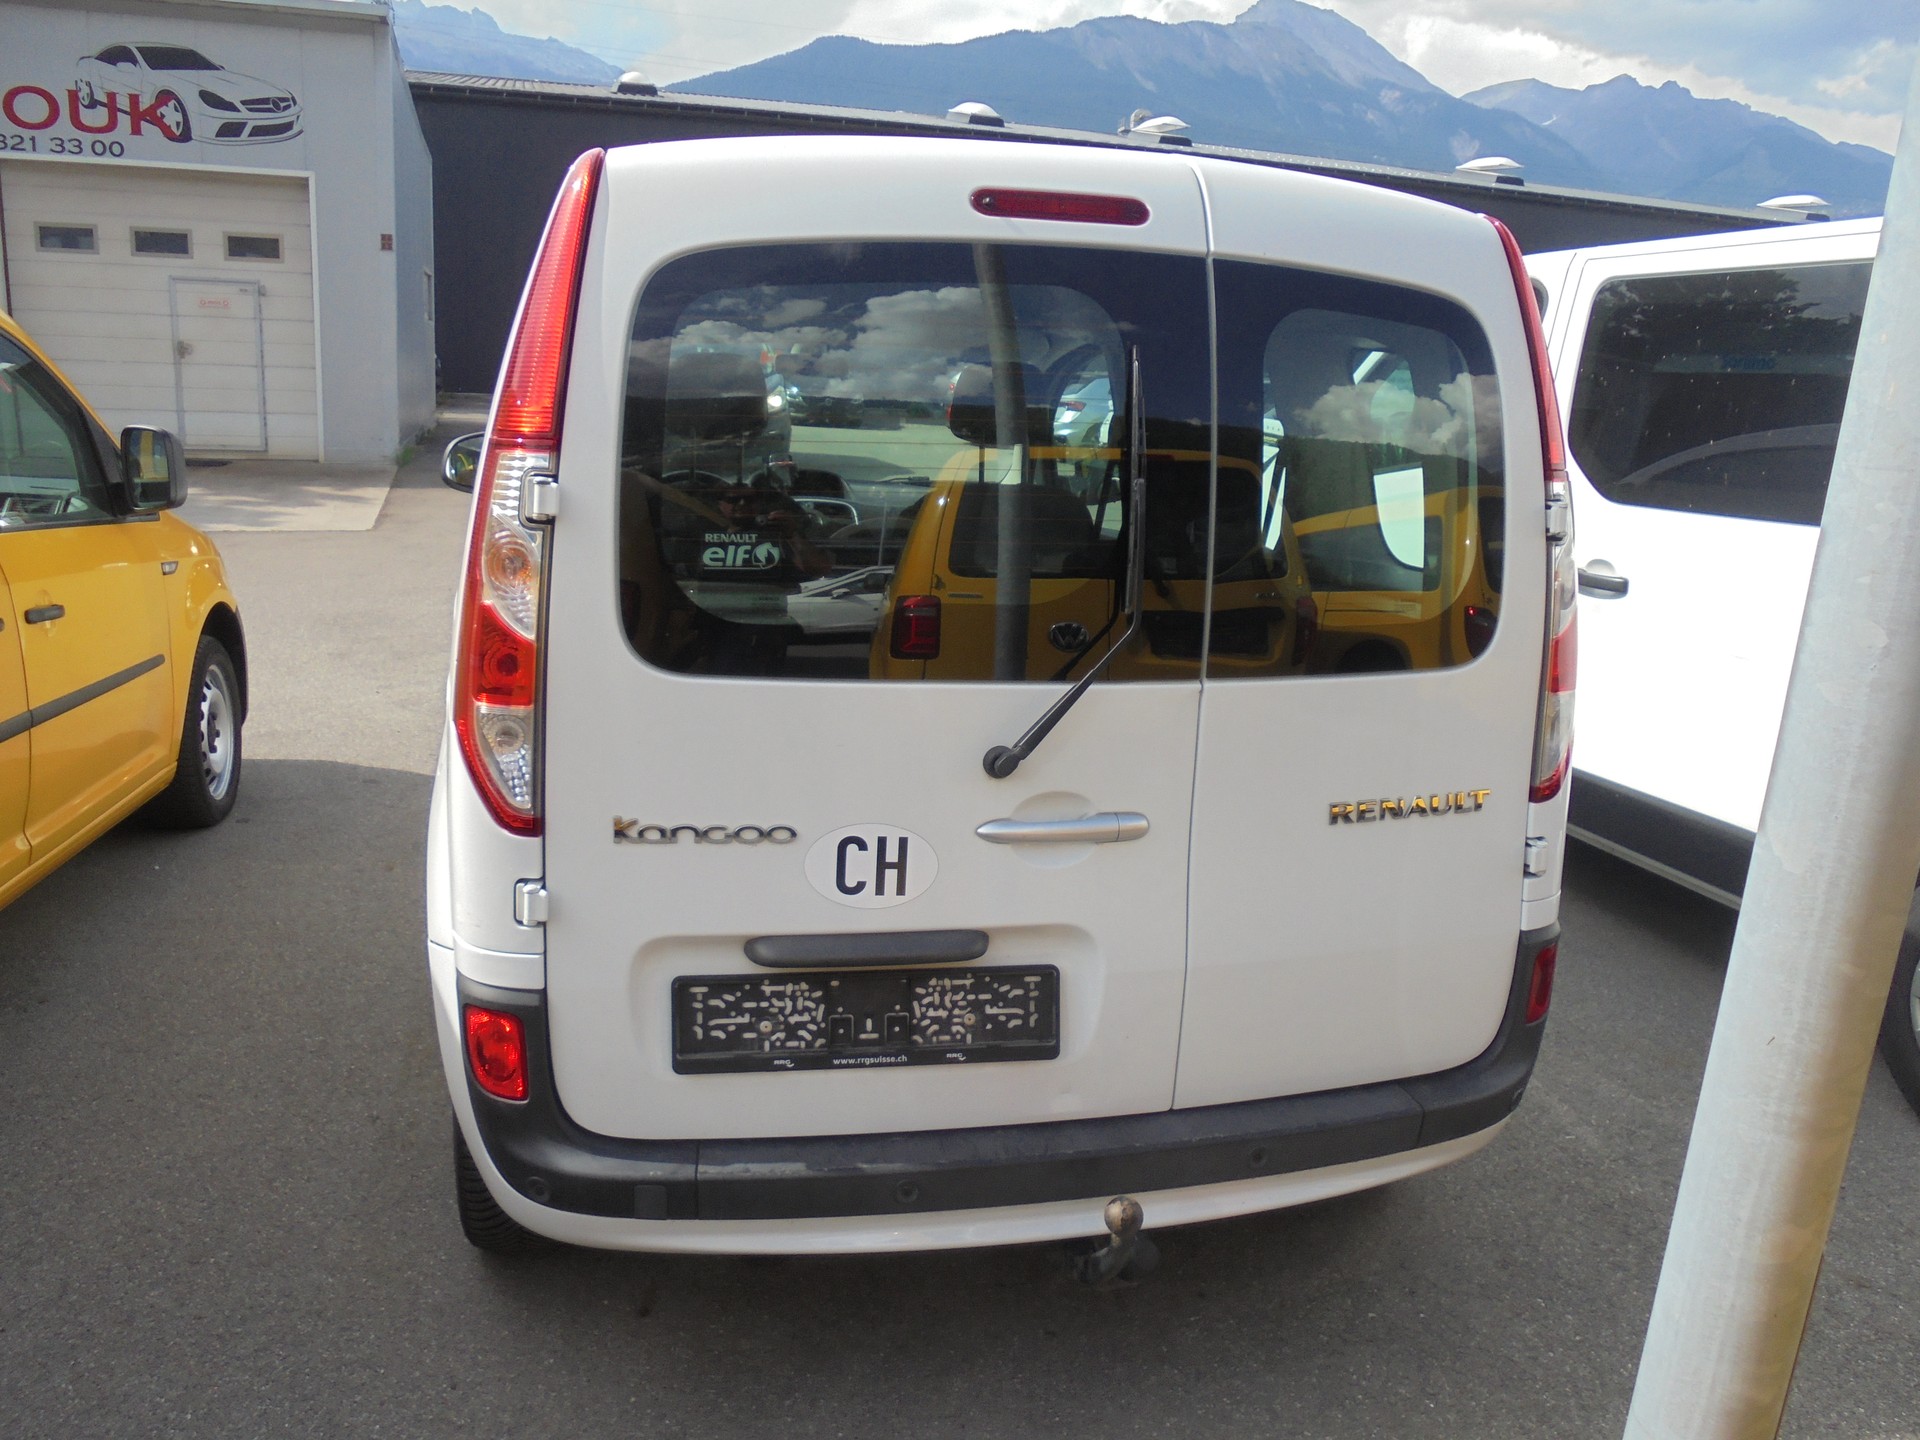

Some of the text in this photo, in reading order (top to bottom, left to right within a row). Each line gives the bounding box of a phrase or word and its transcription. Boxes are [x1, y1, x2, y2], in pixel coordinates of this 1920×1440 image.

[50, 137, 83, 154] 33
[91, 140, 125, 157] 00
[704, 533, 758, 543] RENAULT
[702, 545, 752, 567] elf
[1328, 788, 1491, 826] RENAULT
[612, 815, 798, 845] Kangoo
[835, 835, 909, 897] CH
[832, 1054, 908, 1066] www.rrgsuisse.ch
